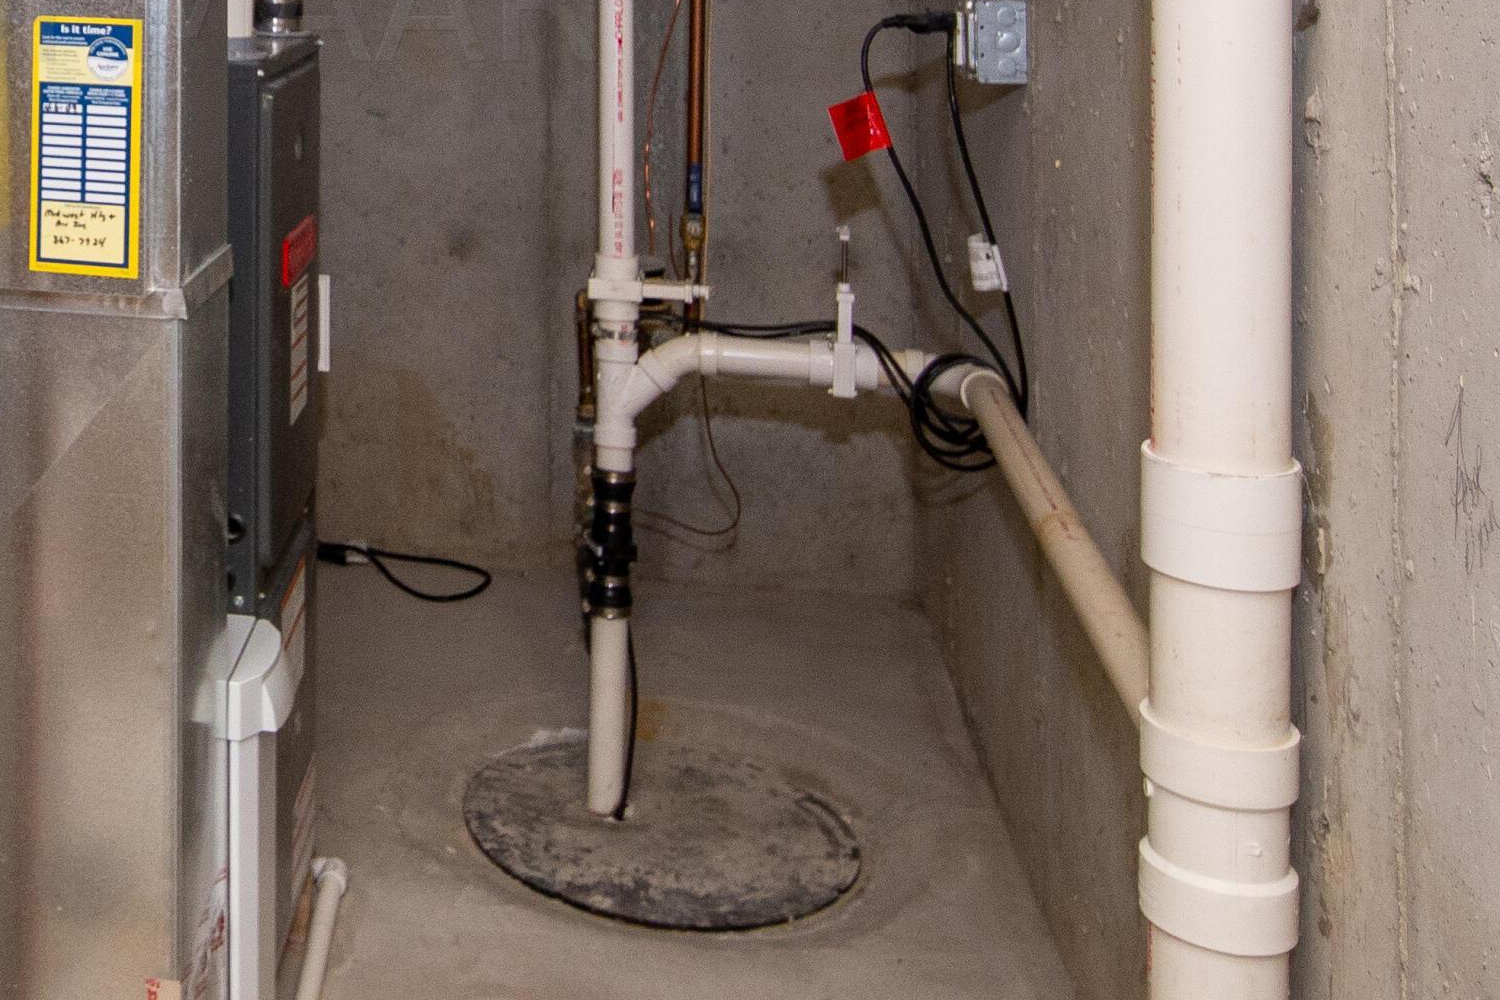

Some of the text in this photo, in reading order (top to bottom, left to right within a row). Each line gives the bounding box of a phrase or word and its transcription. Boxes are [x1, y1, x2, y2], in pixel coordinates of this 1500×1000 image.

[60, 24, 112, 36] Is it time?
